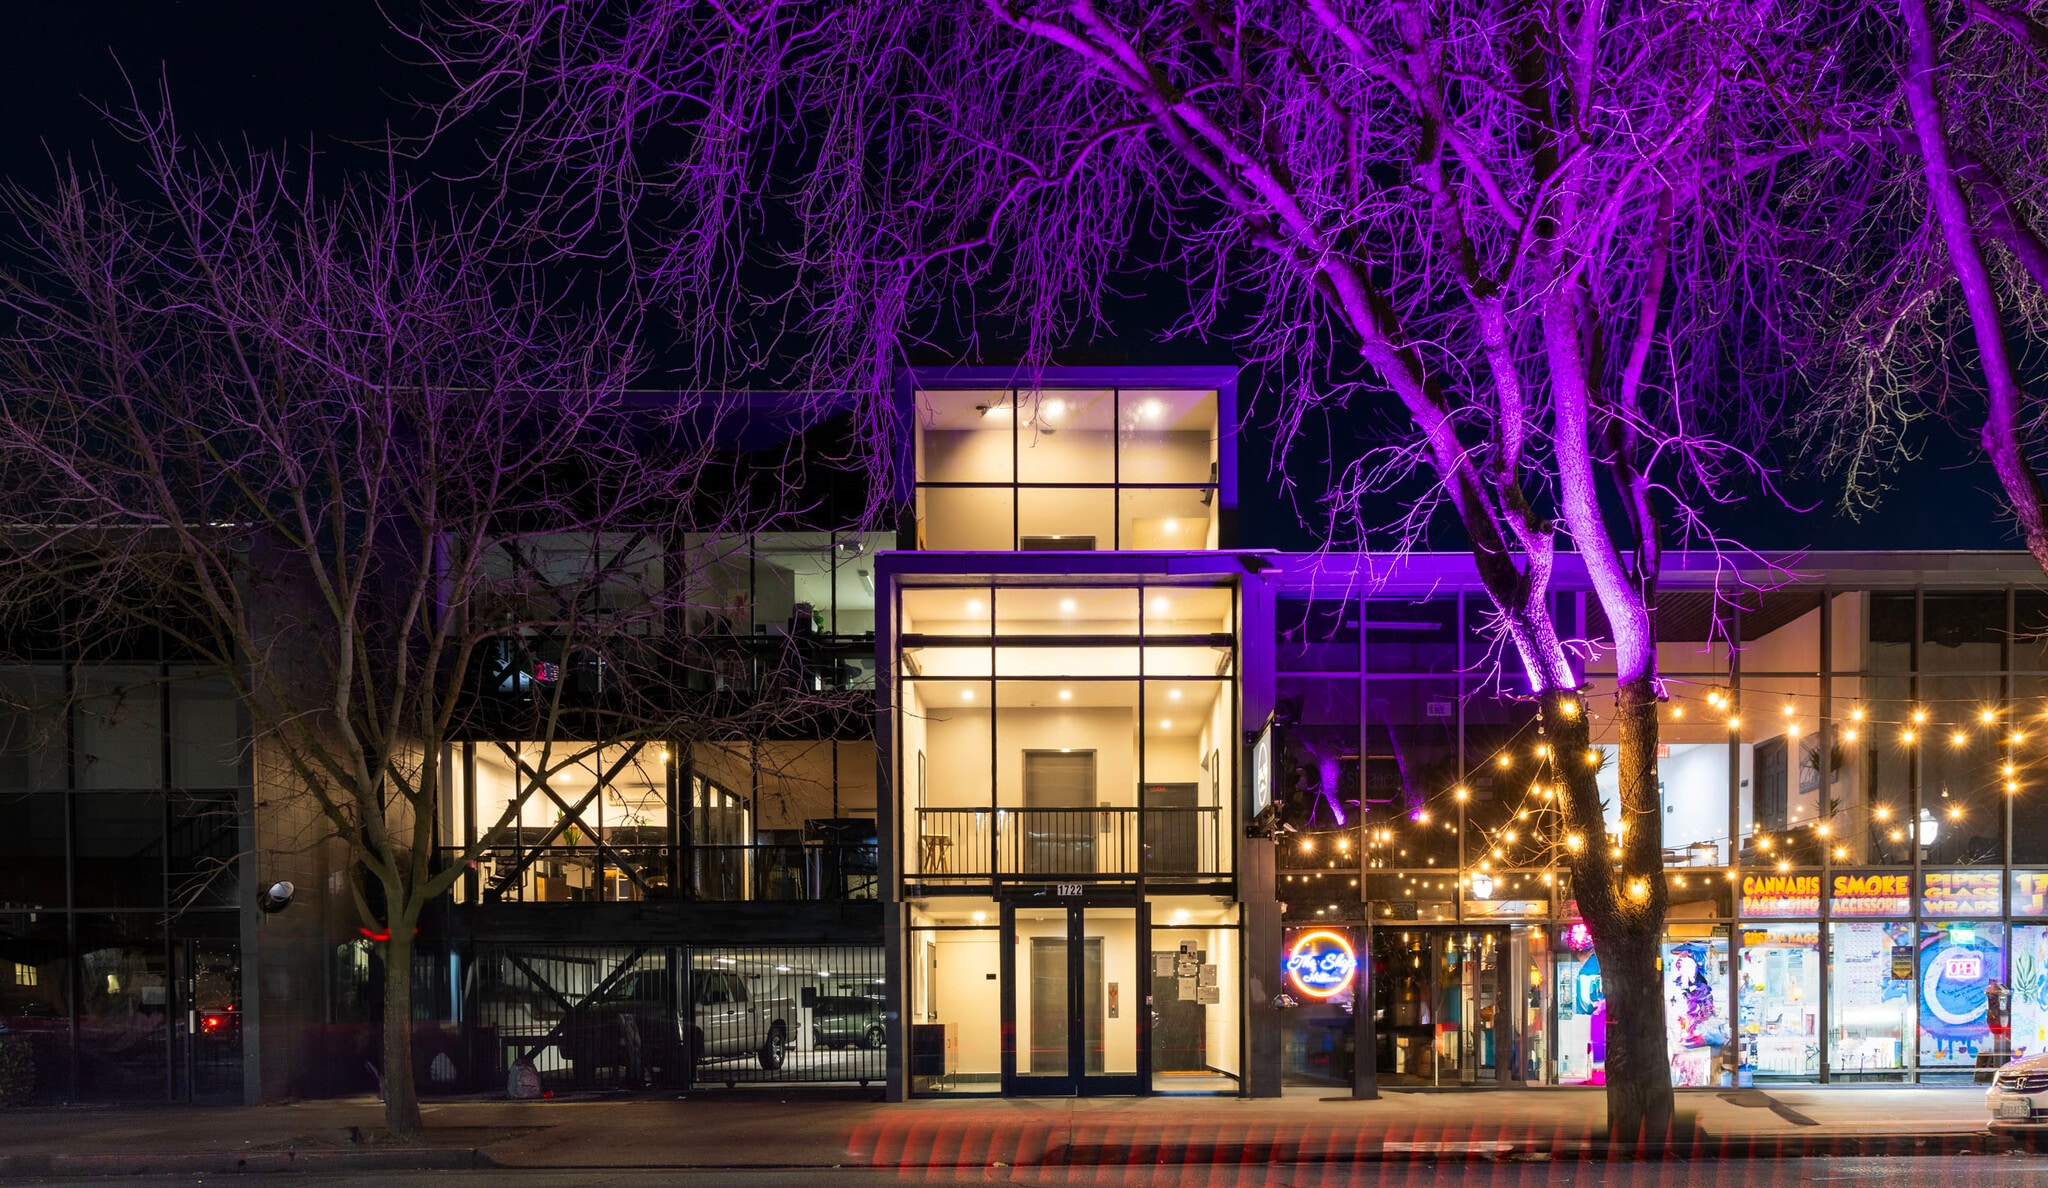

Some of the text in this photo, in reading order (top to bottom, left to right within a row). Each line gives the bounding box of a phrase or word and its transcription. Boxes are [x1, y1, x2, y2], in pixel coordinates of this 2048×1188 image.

[1743, 875, 1820, 896] CANNABIS
[1834, 875, 1910, 896] SMOKE
[1925, 873, 2000, 887] PIPES
[1058, 885, 1082, 895] 1722
[1924, 887, 2000, 900] GLASS
[1743, 896, 1820, 913] PACKAGING
[1832, 897, 1911, 914] ACCESSORIES
[1924, 900, 2000, 914] WRAPS
[1787, 932, 1819, 944] BAGS
[1949, 961, 1978, 976] OPEN
